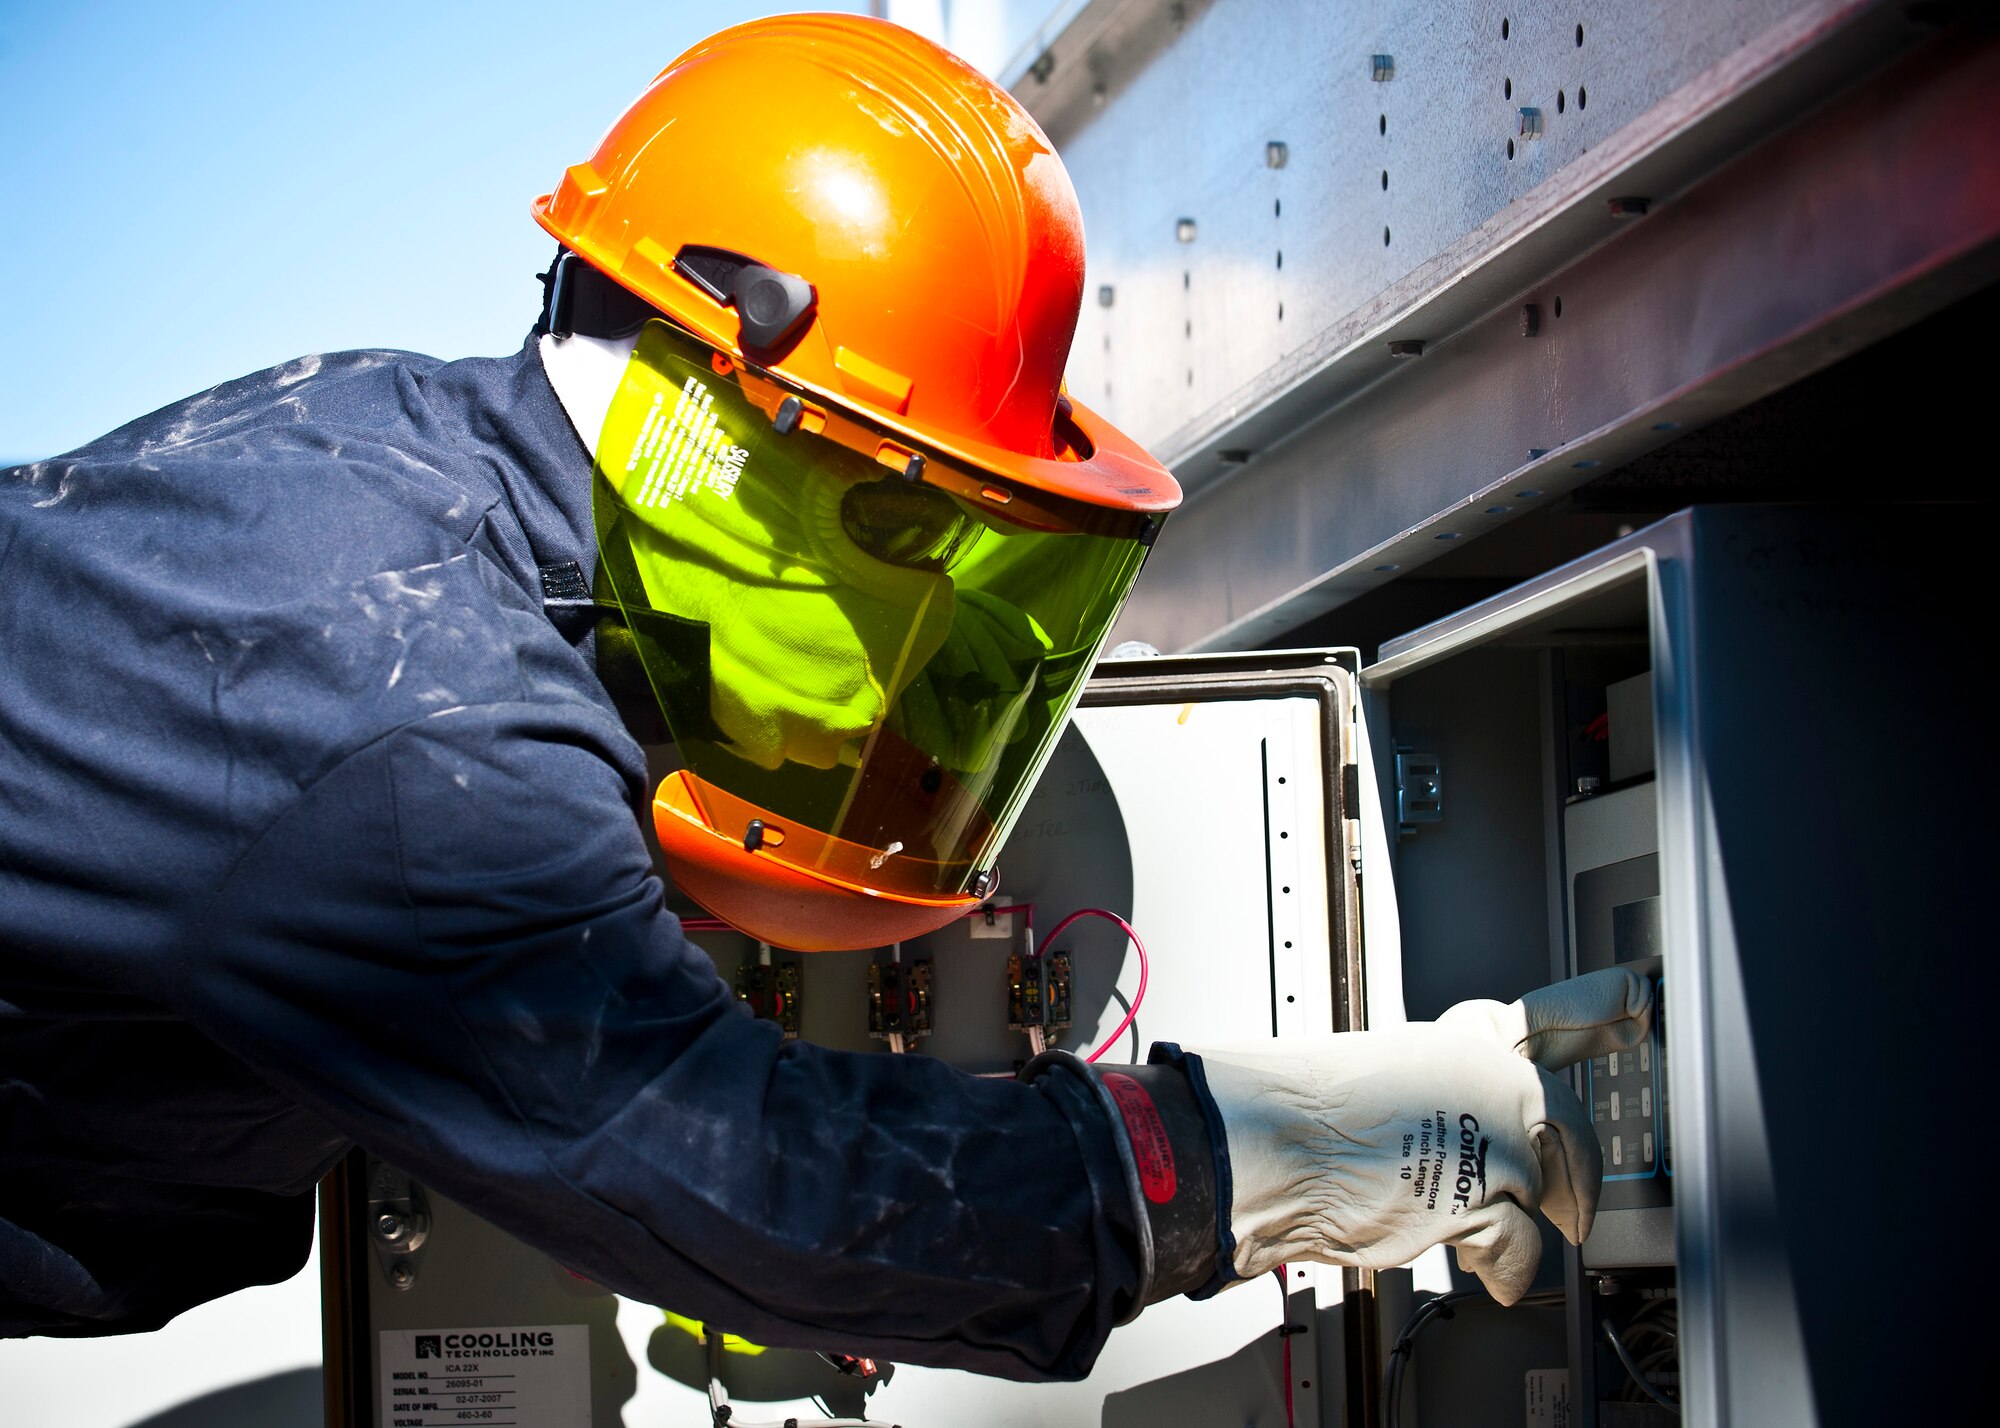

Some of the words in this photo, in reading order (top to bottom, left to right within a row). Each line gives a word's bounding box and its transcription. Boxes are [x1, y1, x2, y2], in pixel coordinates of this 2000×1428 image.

[712, 445, 749, 501] SALISBURY
[1421, 1118, 1432, 1129] 10
[1436, 1110, 1447, 1149] Leather
[1146, 1106, 1172, 1169] SALISBURY
[1420, 1131, 1432, 1155] Inch
[1402, 1133, 1414, 1158] Size
[1453, 1113, 1480, 1208] Condor
[1400, 1165, 1412, 1180] 10
[1414, 1158, 1430, 1197] Length
[1427, 1151, 1447, 1210] Protectors
[445, 1332, 554, 1349] COOLING
[445, 1348, 538, 1358] TECHNOLOGY
[445, 1364, 461, 1373] ICA
[463, 1364, 479, 1372] 22X
[393, 1372, 416, 1380] MODEL
[446, 1379, 483, 1388] 26095-01
[393, 1388, 417, 1396] SERIAL
[456, 1395, 501, 1404] 02-07-2007
[394, 1404, 410, 1412] DATE
[456, 1411, 492, 1419] 460-3-60
[394, 1419, 423, 1427] VOLTAGE
